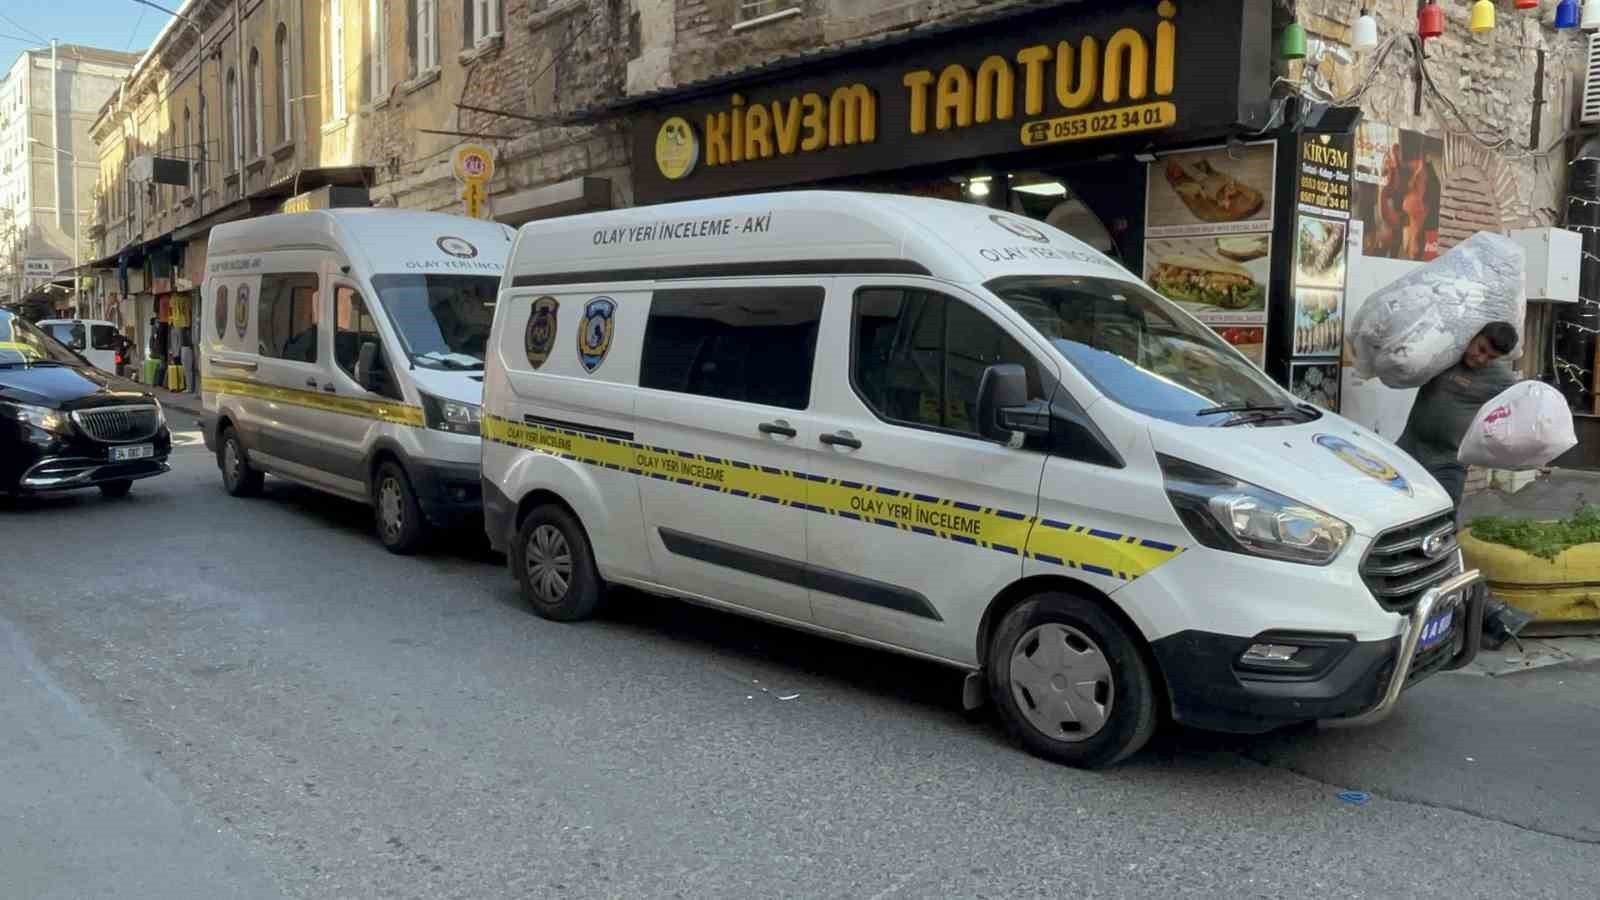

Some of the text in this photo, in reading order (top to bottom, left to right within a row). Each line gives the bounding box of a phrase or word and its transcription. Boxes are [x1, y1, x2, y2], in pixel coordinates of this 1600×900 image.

[903, 0, 1177, 134] TANTUNİ
[1054, 109, 1162, 138] 0553 022 34 01
[1329, 183, 1338, 194] 34
[1329, 196, 1339, 208] 34
[593, 228, 628, 245] OLAY
[629, 221, 657, 243] YERİ
[659, 217, 732, 240] İNCELEME
[743, 211, 772, 233] AKİ
[507, 427, 524, 441] OLAY
[637, 453, 660, 468] OLAY
[661, 455, 680, 472] YERİ
[850, 495, 981, 535] OLAY YERİ İNCELEME
